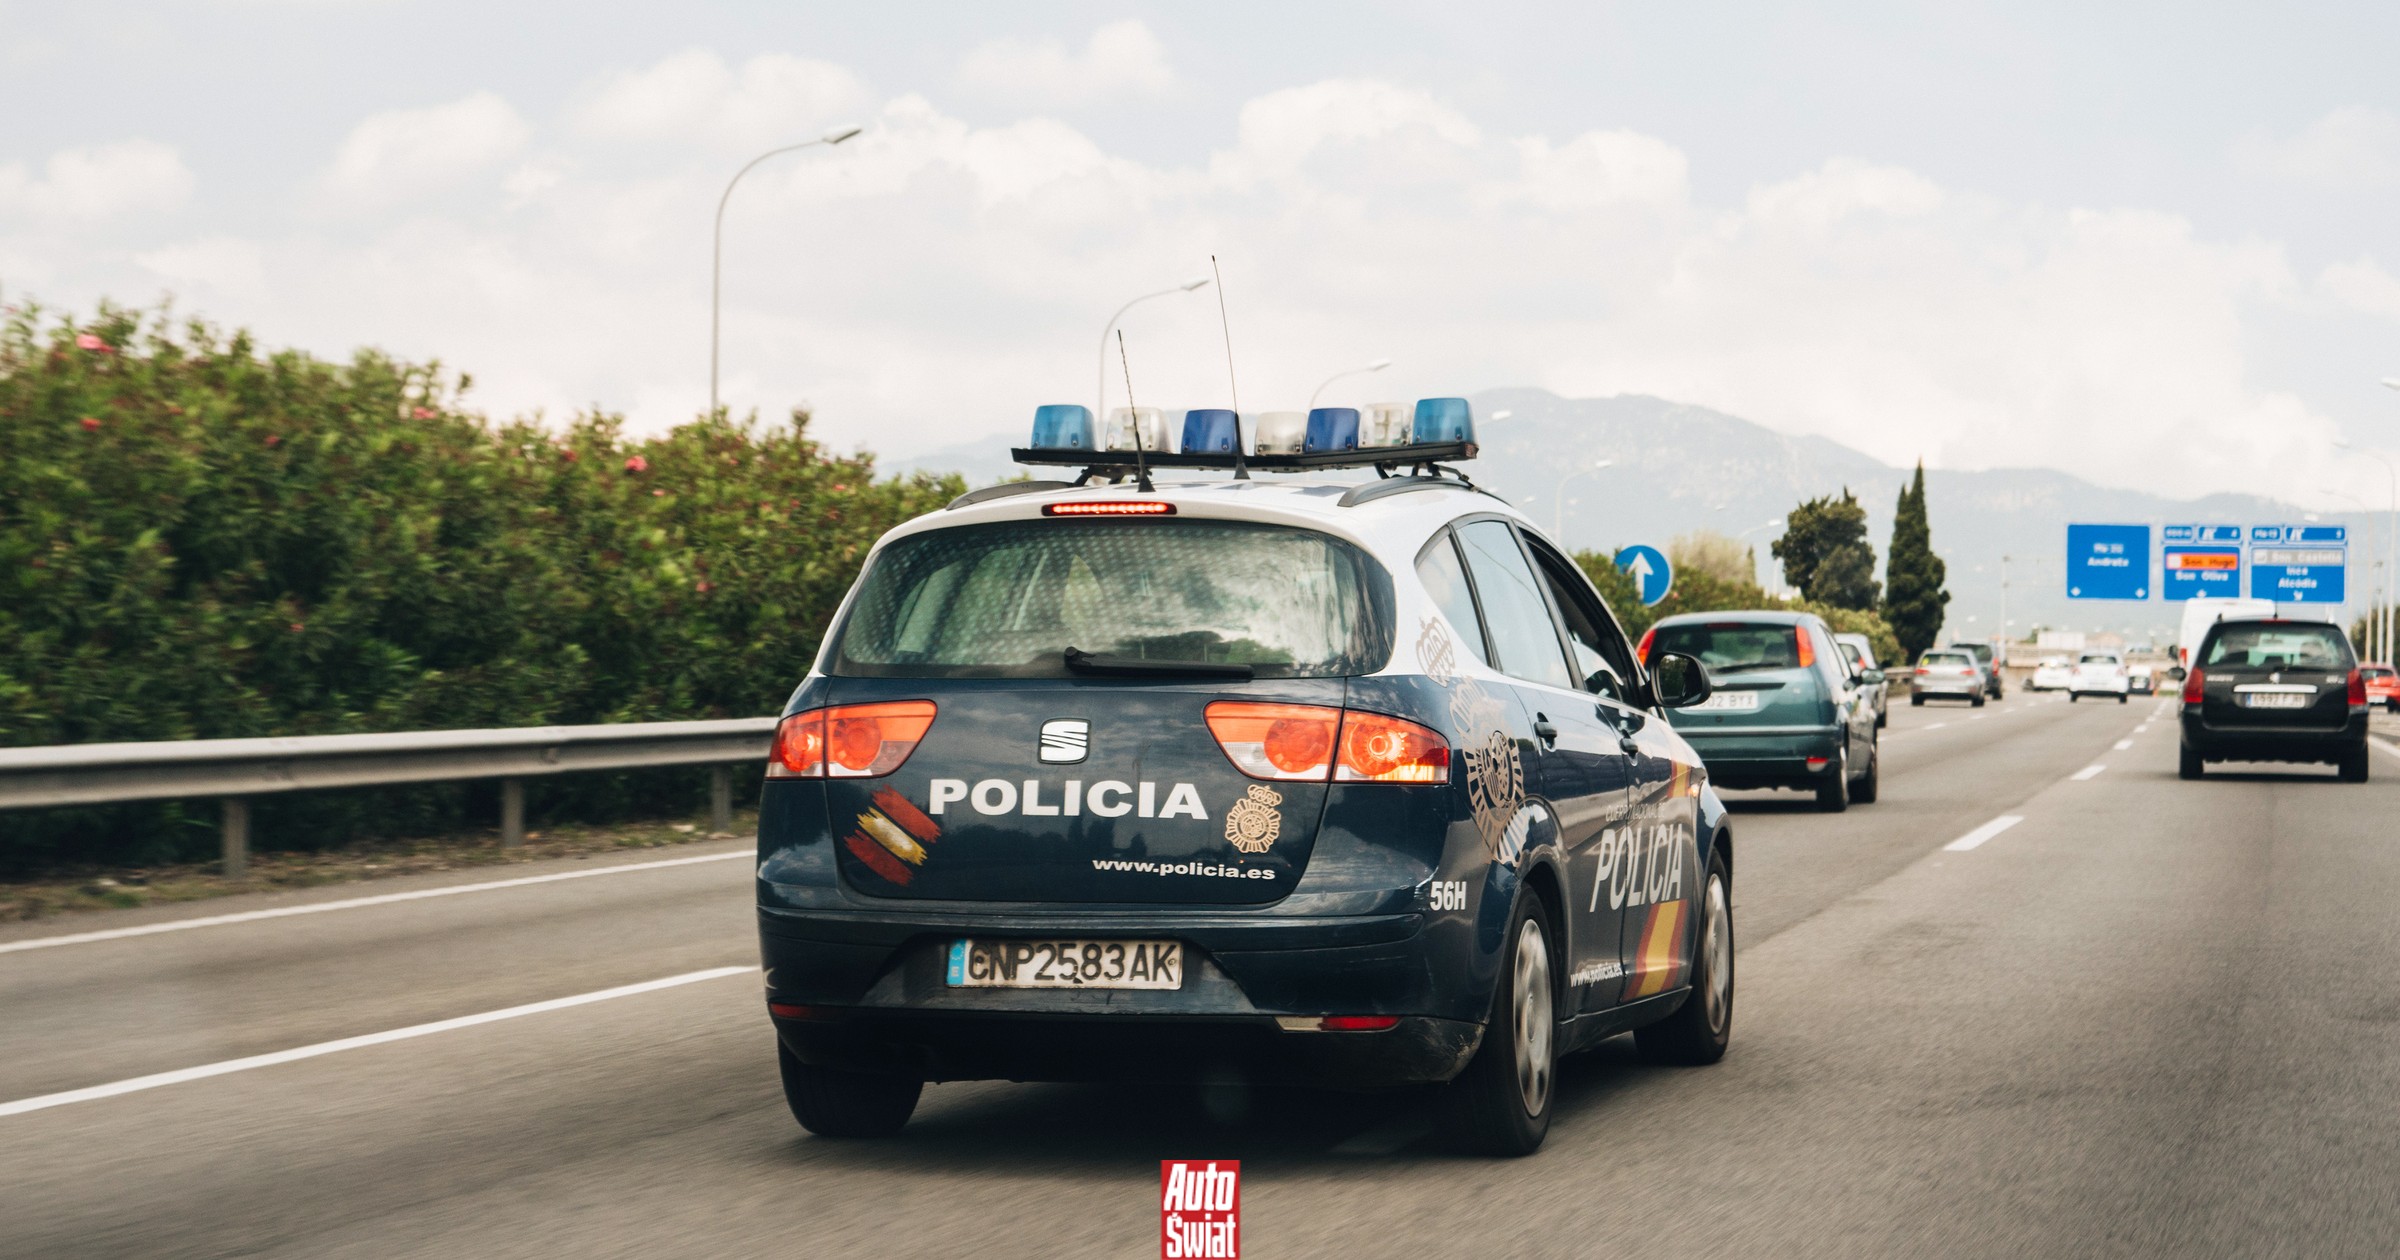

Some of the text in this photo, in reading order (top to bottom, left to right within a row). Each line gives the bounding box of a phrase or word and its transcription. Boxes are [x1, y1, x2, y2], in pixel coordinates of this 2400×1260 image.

[929, 779, 1209, 820] POLICIA
[1092, 859, 1276, 880] www.policia.es
[1589, 823, 1683, 913] POLICIA
[1430, 881, 1467, 911] 56H
[1570, 962, 1623, 988] www.policia.es
